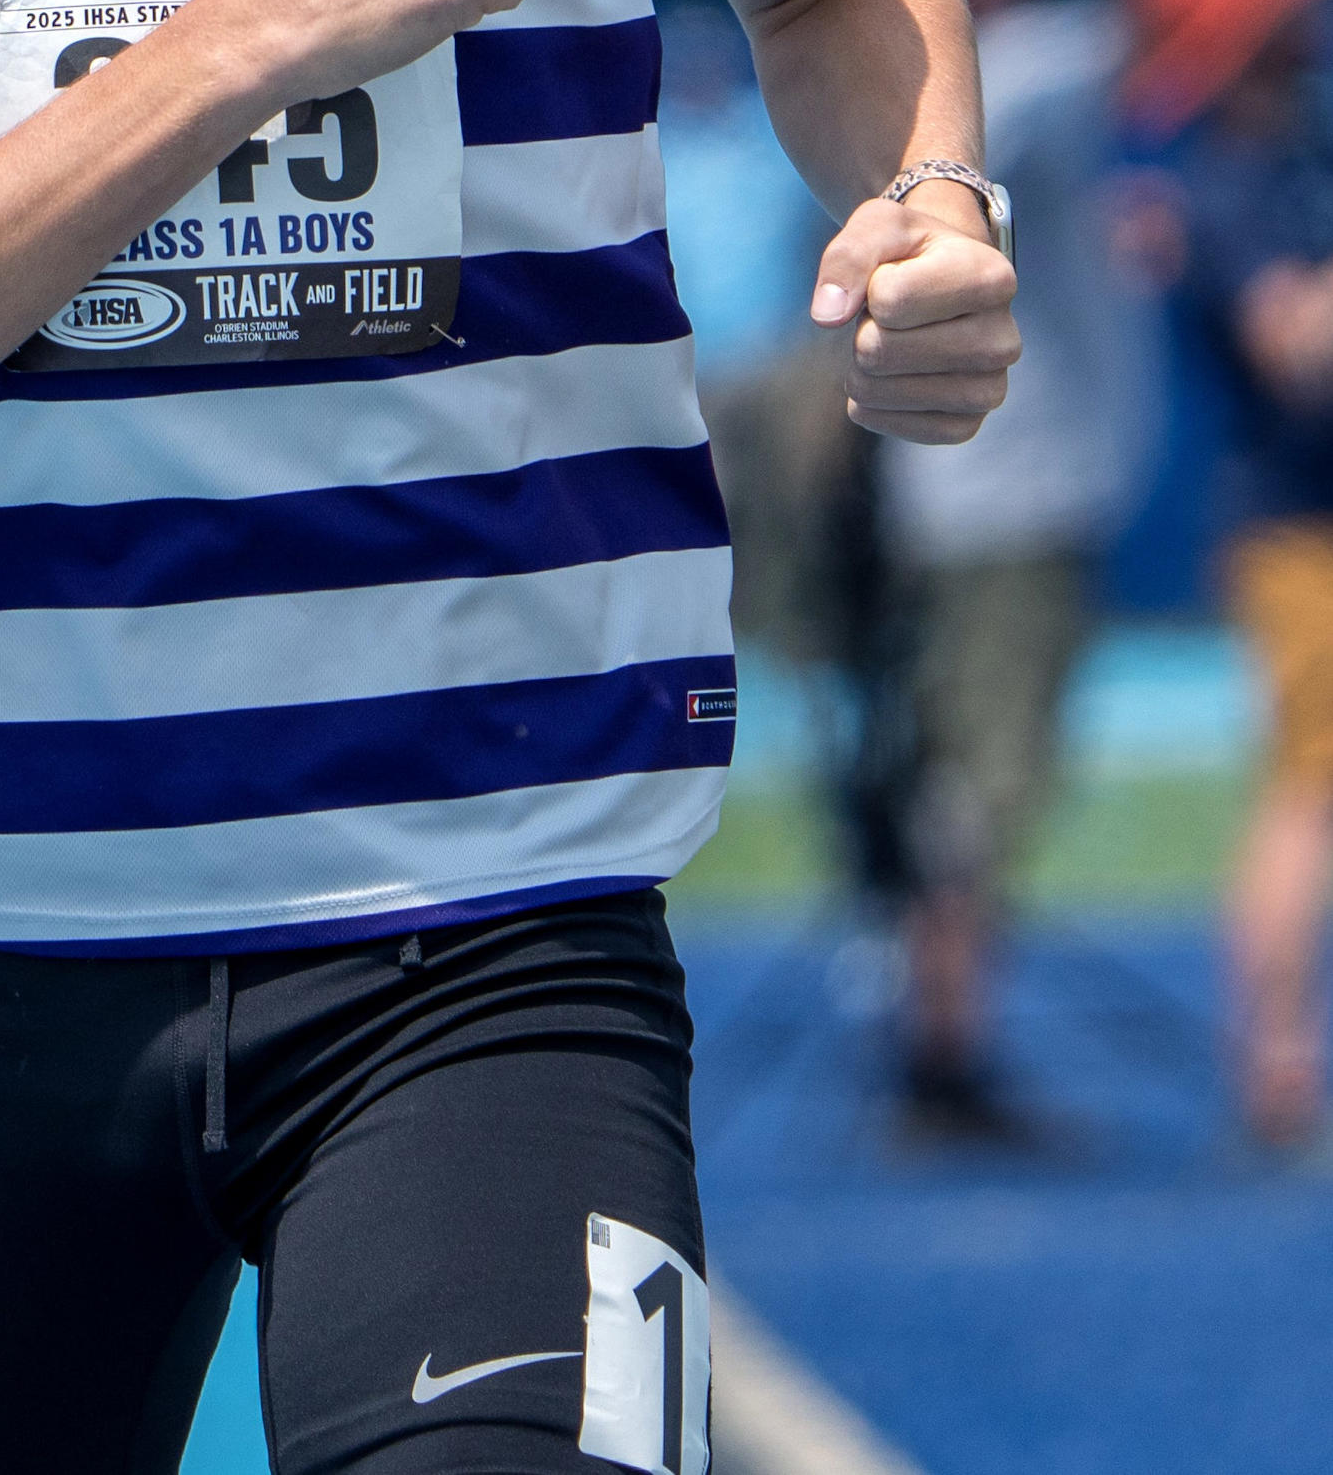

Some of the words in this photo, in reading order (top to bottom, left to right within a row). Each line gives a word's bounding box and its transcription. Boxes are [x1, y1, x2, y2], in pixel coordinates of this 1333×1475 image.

[26, 9, 75, 29] 2025
[84, 6, 129, 26] IHSA
[218, 215, 267, 257] 1A
[278, 210, 375, 255] BOYS
[195, 271, 301, 321] TRACK
[305, 283, 336, 305] AND
[343, 266, 424, 315] FIELD
[71, 296, 146, 327] IHSA
[203, 332, 264, 344] CHARLESTON,
[264, 330, 300, 342] ILLINOIS
[249, 321, 289, 332] STADIUM
[349, 319, 412, 337] Athletic
[632, 1260, 683, 1475] 1
